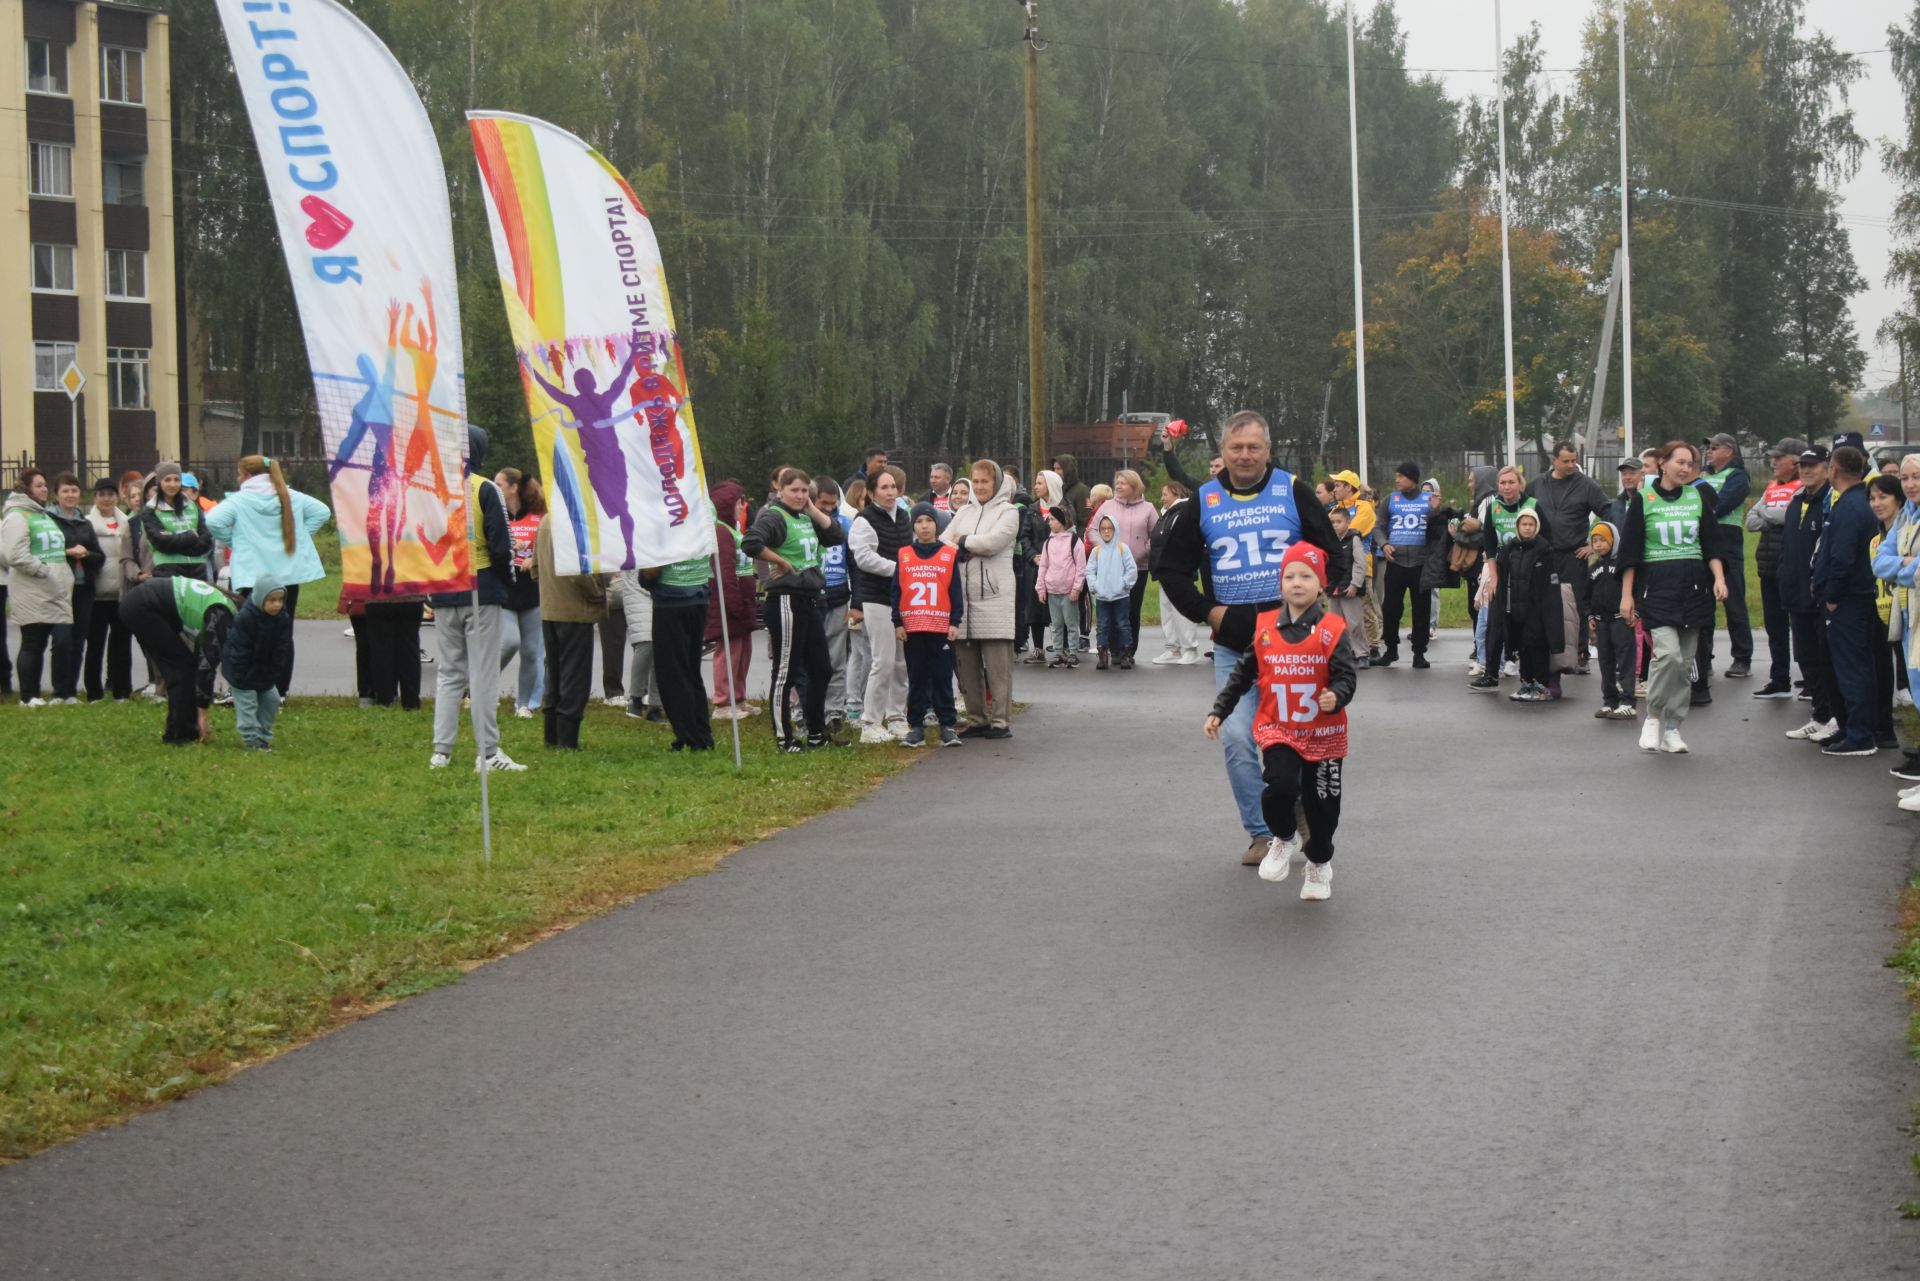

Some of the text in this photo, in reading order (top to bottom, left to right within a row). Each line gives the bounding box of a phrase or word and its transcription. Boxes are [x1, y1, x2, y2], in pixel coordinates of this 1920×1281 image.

[242, 1, 363, 285] Я СПОРТ!
[604, 196, 642, 287] СПОРТА!
[625, 293, 658, 370] РИТМЕ
[1211, 504, 1286, 524] ТУКАЕВСКИЙ
[1228, 515, 1270, 529] РАЙОН
[1391, 513, 1428, 530] 205
[36, 530, 65, 551] 15
[1655, 520, 1698, 546] 113
[1210, 529, 1290, 571] 213
[904, 565, 946, 574] ТУКАЕВСКИЙ
[908, 581, 938, 607] 21
[1274, 664, 1315, 676] РАЙОН
[1270, 683, 1320, 723] 13
[1314, 724, 1345, 737] ЖИЗНИ
